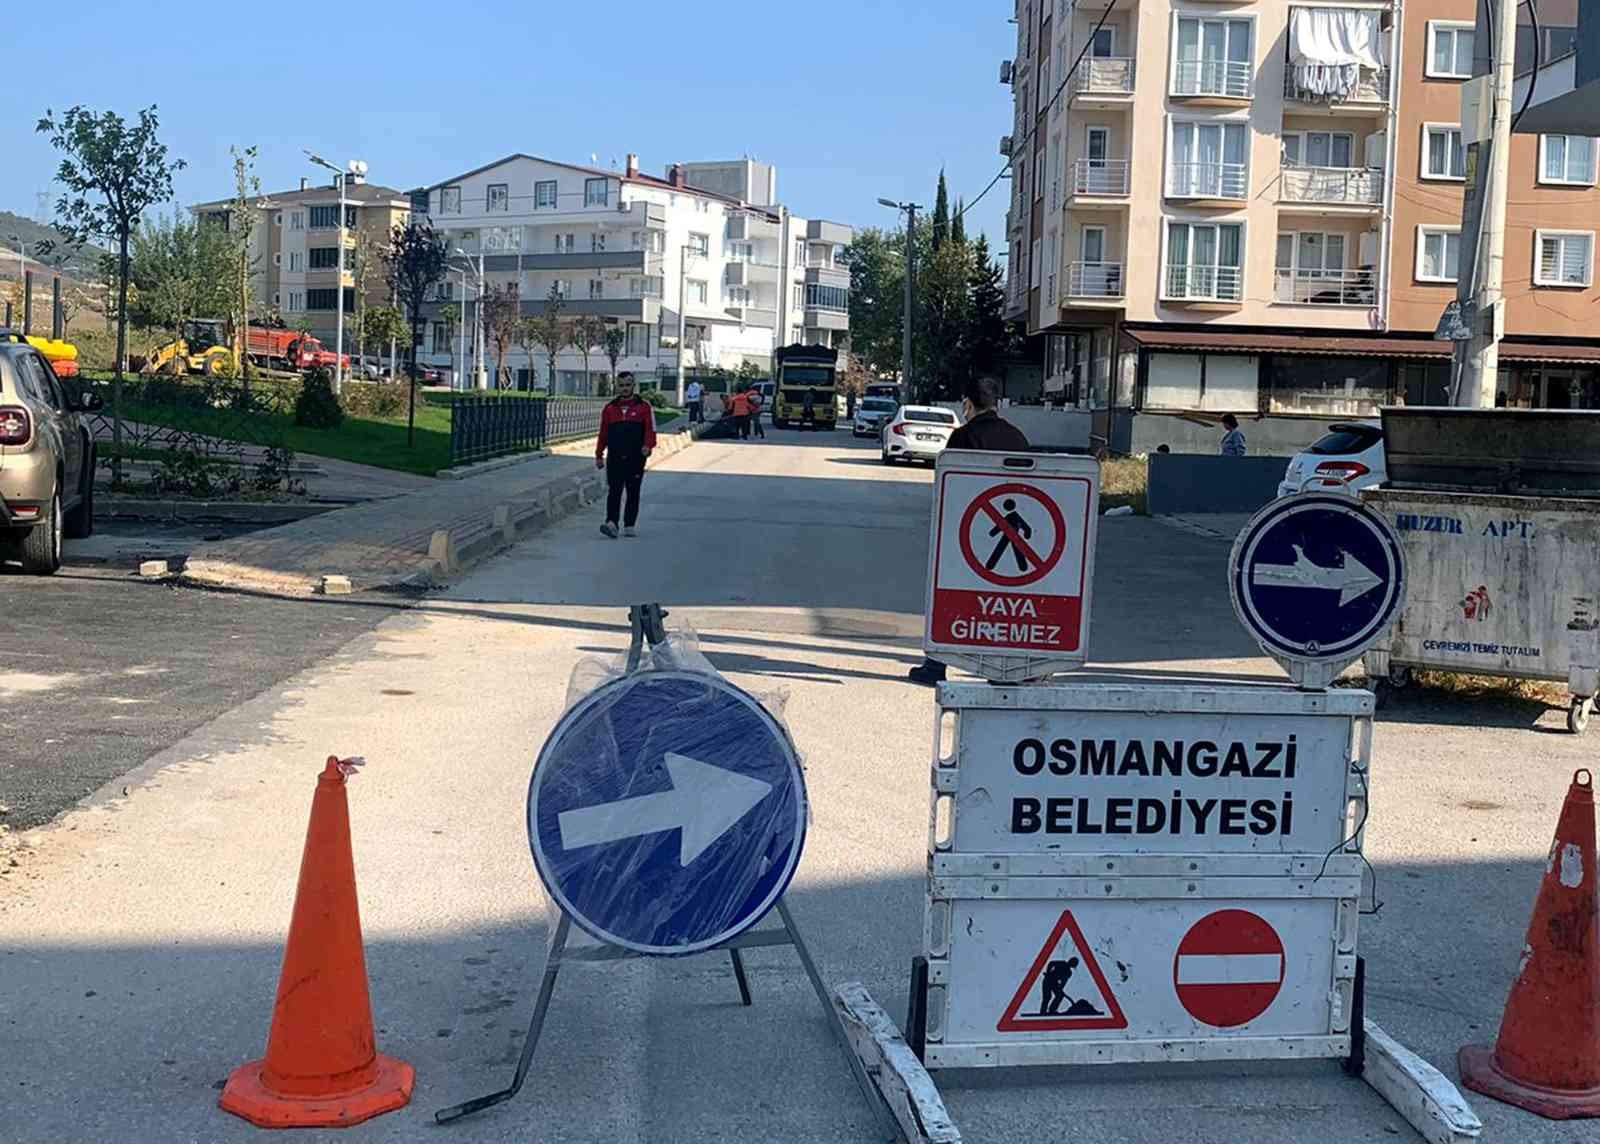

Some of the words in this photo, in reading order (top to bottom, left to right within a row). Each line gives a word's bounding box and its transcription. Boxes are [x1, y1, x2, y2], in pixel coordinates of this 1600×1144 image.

[1396, 514, 1464, 534] HUZUR
[977, 596, 1037, 618] YAYA
[951, 616, 1061, 644] GİREMEZ
[1501, 645, 1540, 657] TUTALIM
[1013, 734, 1297, 778] OSMANGAZİ
[1011, 790, 1293, 835] BELEDİYESİ
